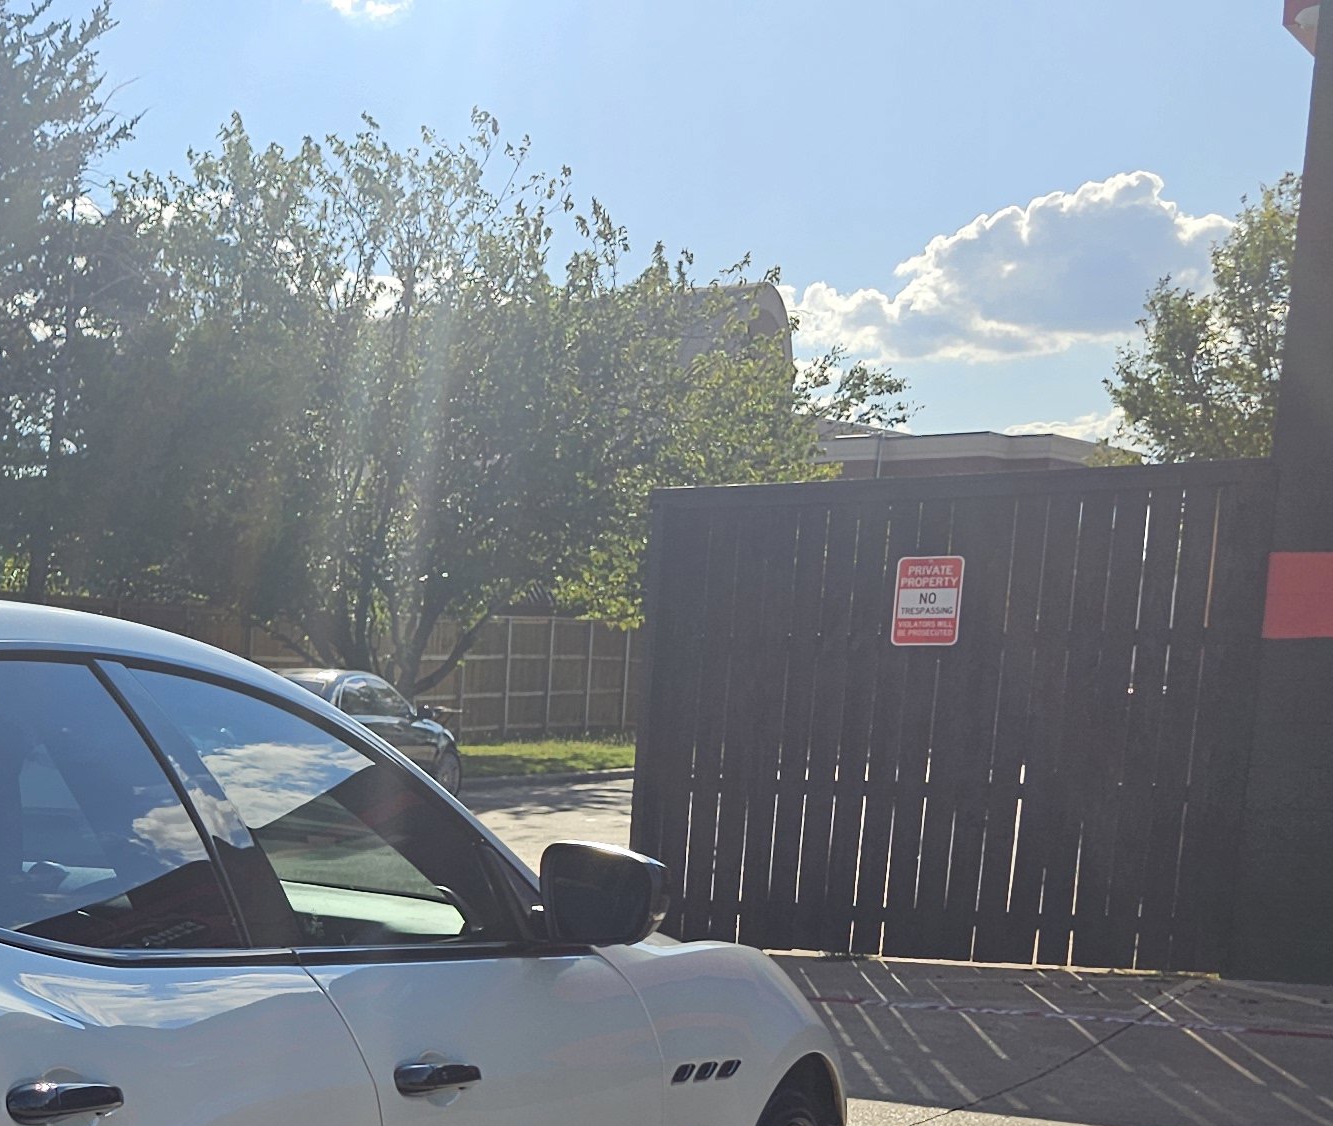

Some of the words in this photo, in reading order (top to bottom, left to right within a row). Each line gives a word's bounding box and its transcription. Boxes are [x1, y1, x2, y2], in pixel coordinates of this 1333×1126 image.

[908, 565, 954, 576] PRIVATE
[900, 576, 959, 588] PROPERTY
[918, 592, 937, 605] NO
[901, 606, 953, 616] TRESPASSING
